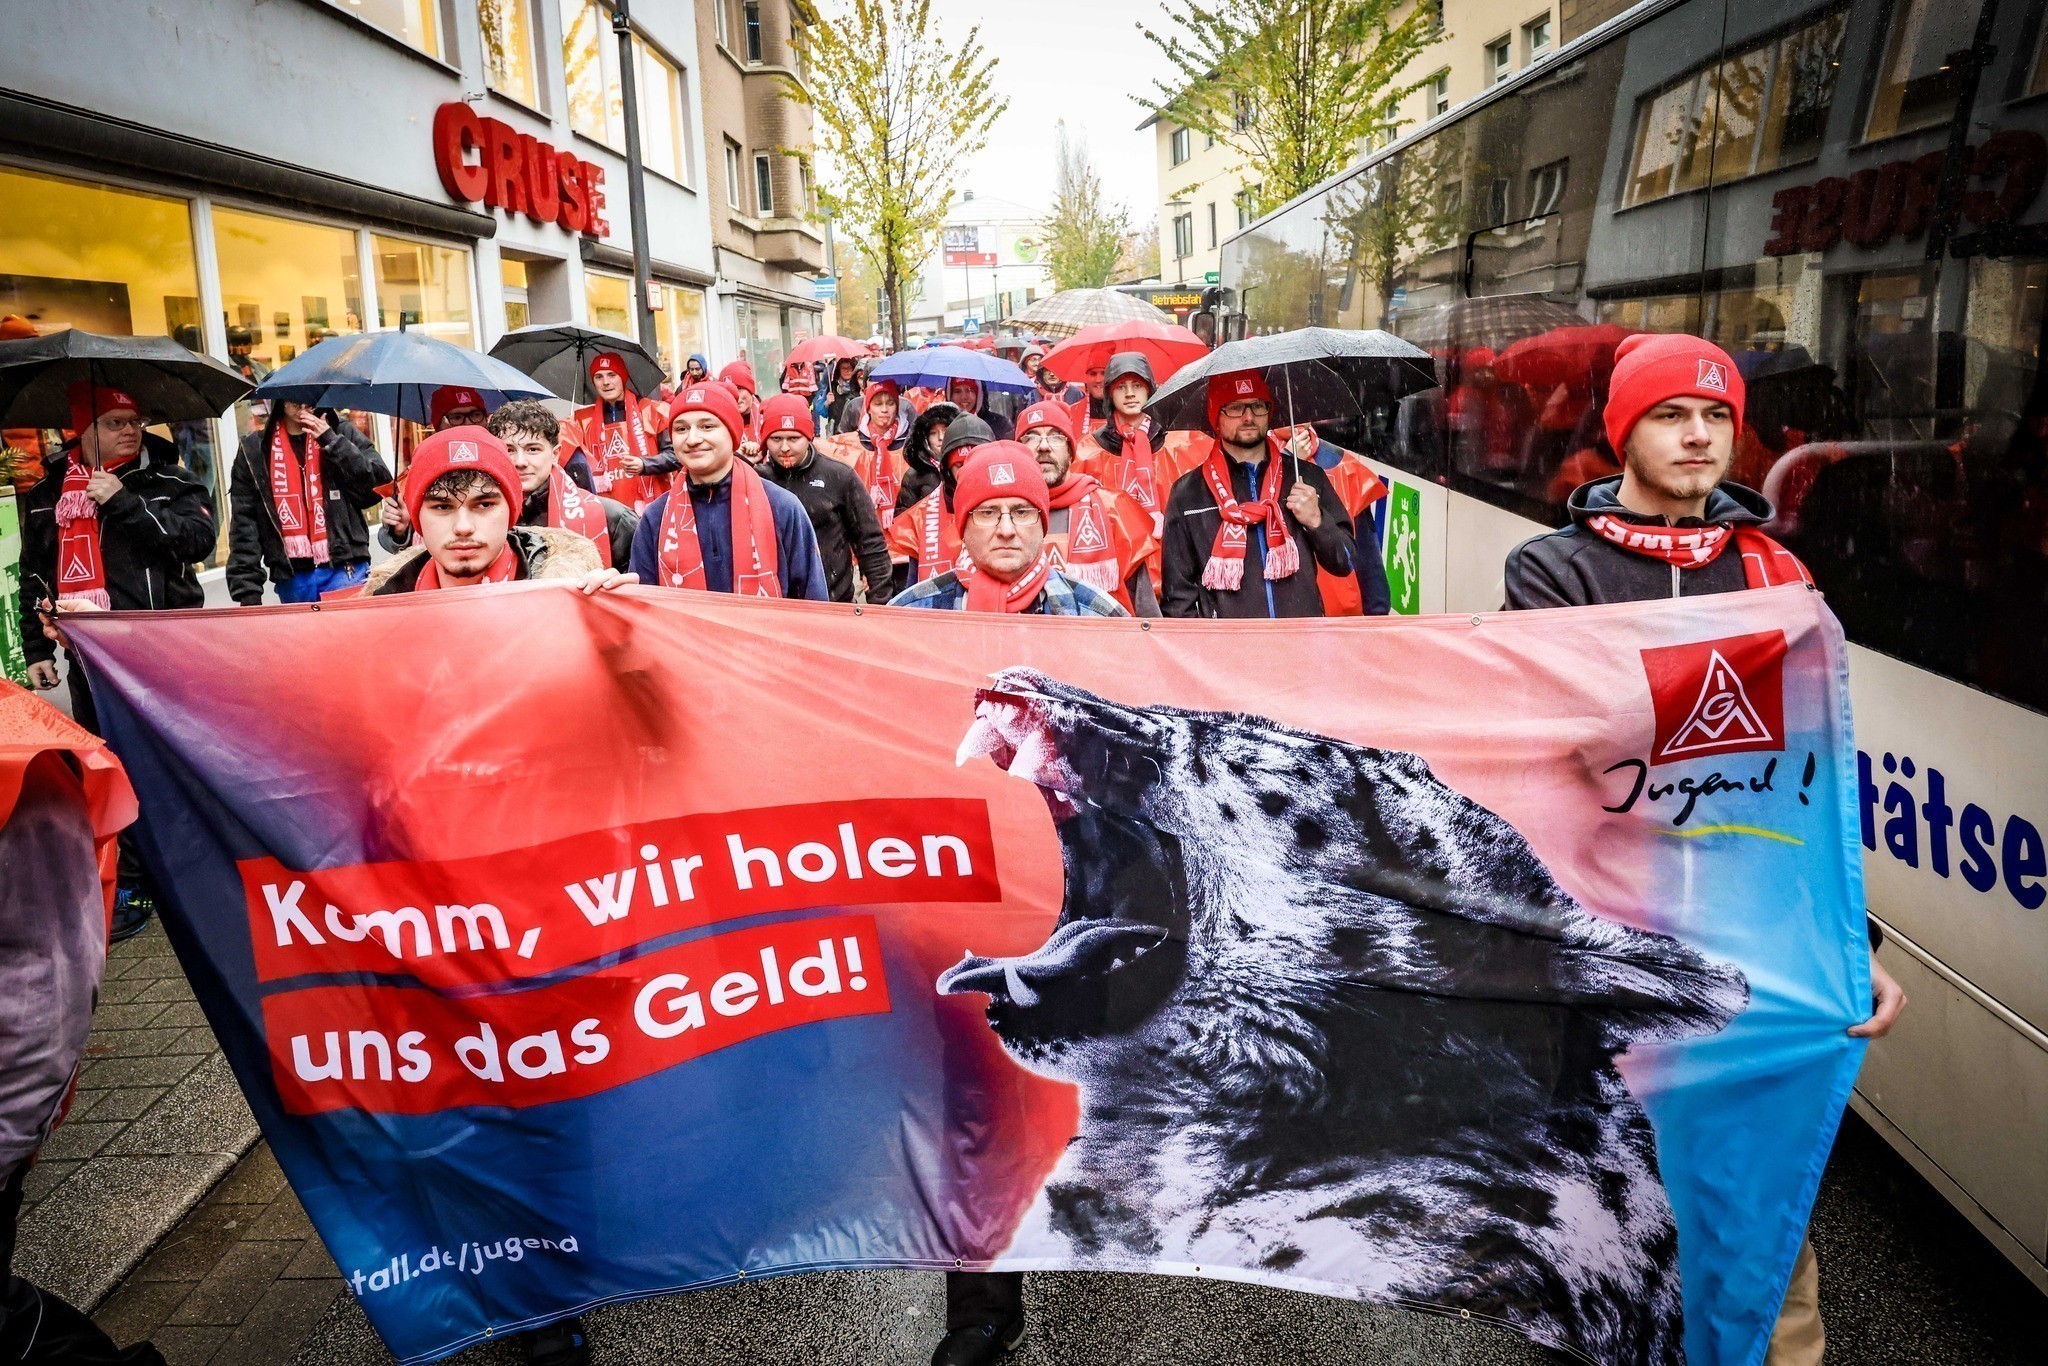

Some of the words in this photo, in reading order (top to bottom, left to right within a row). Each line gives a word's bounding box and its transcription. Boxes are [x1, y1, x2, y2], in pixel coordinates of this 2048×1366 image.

[433, 102, 610, 238] CRUSE
[262, 880, 542, 960] Komm,
[564, 843, 703, 927] wir
[726, 822, 973, 891] holen
[291, 1030, 433, 1083] uns
[454, 1018, 611, 1083] das
[633, 936, 867, 1040] Geld!
[345, 1235, 579, 1296] tall.de/jugend
